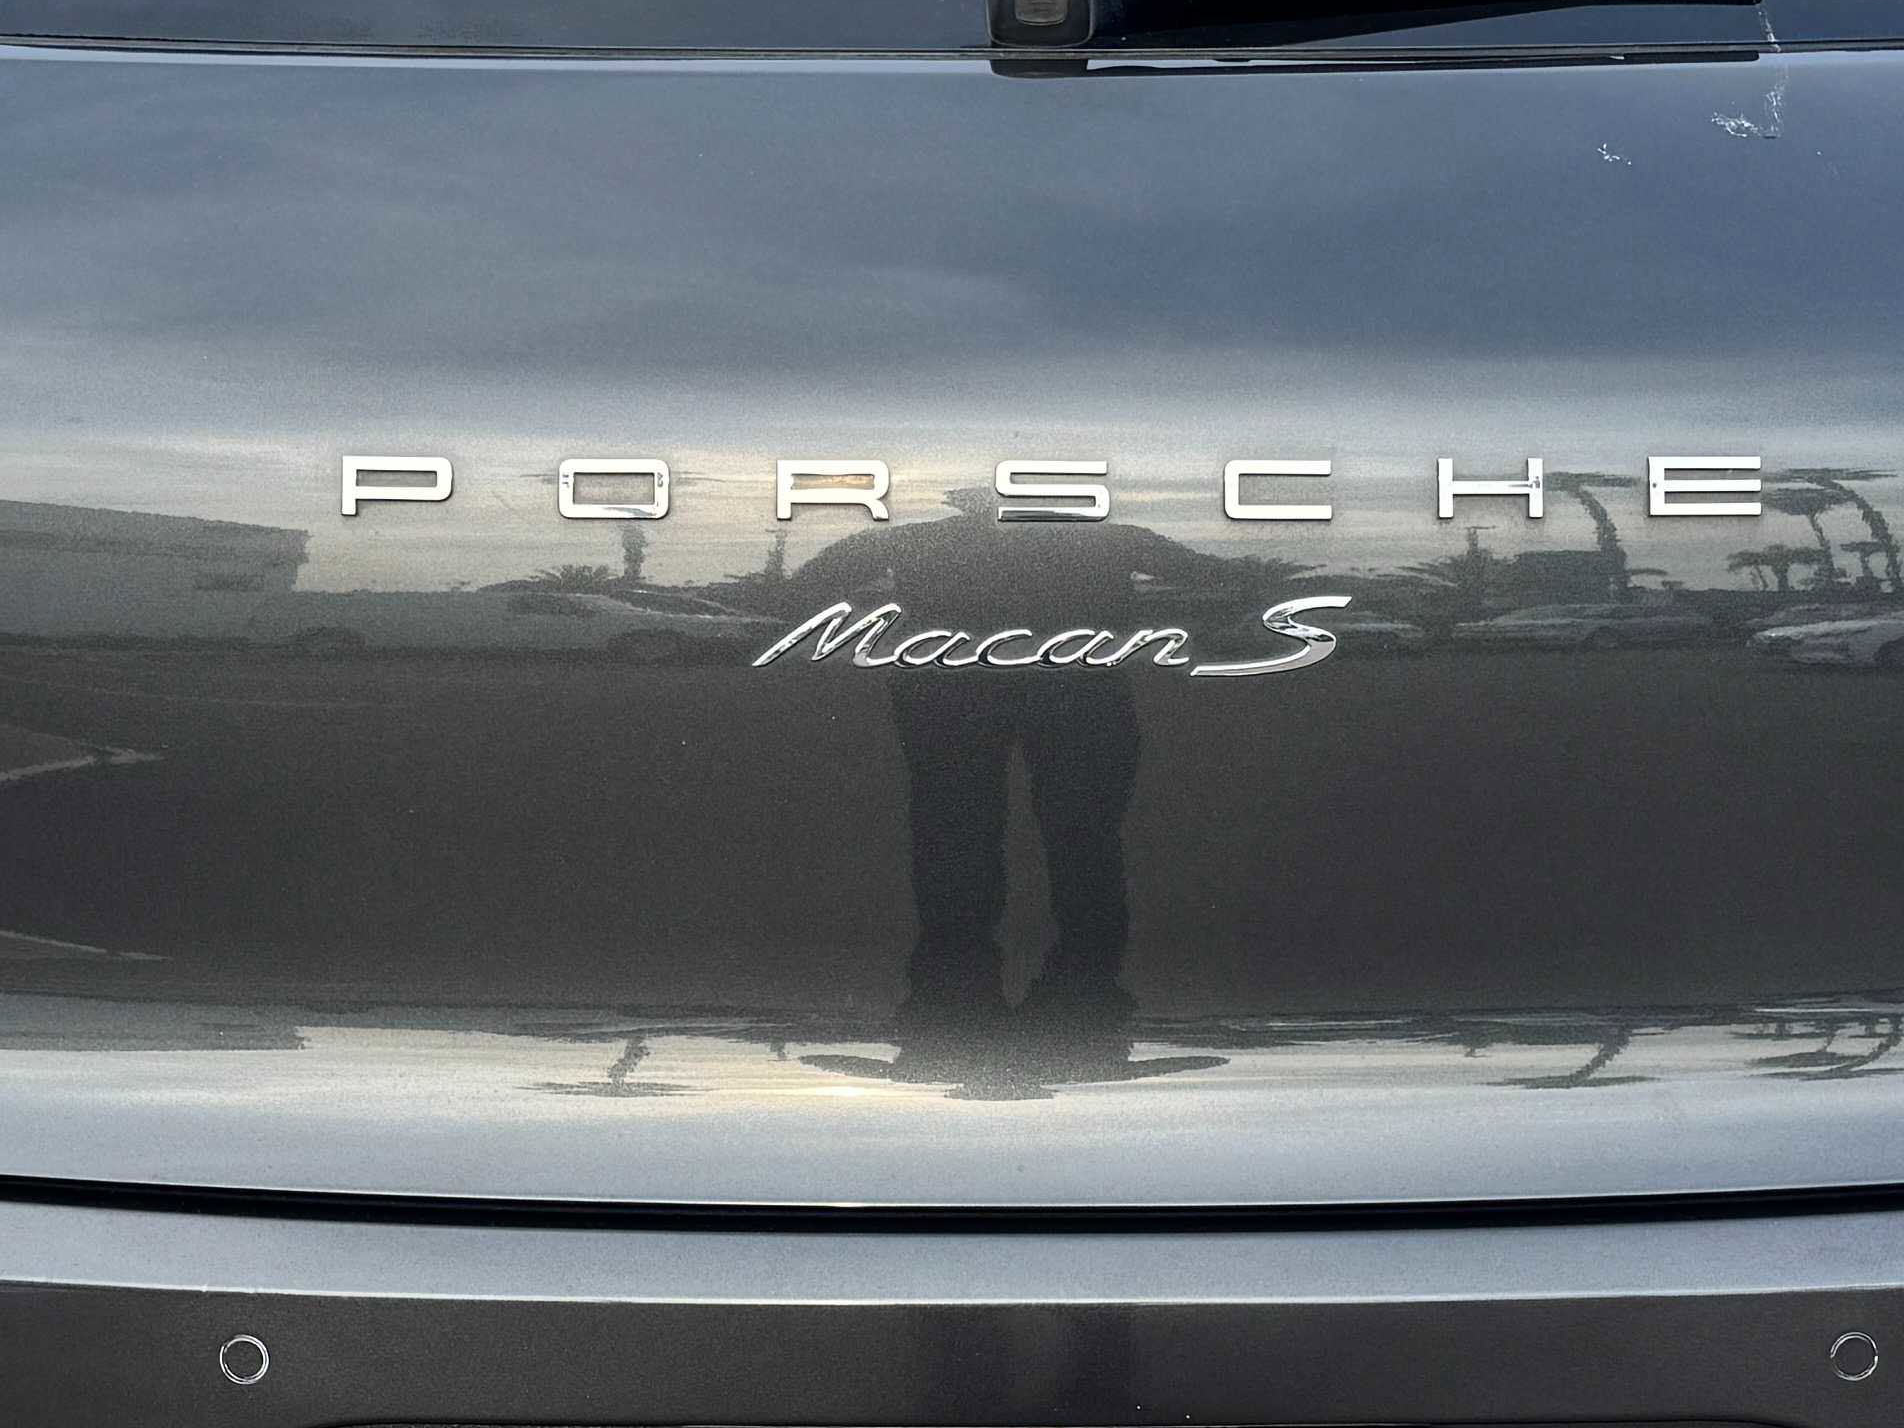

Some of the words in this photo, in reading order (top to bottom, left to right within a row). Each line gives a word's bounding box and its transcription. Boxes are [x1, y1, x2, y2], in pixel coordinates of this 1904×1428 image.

[340, 454, 1763, 522] PORSCHE
[752, 601, 1193, 669] Macan
[1191, 594, 1353, 678] S
